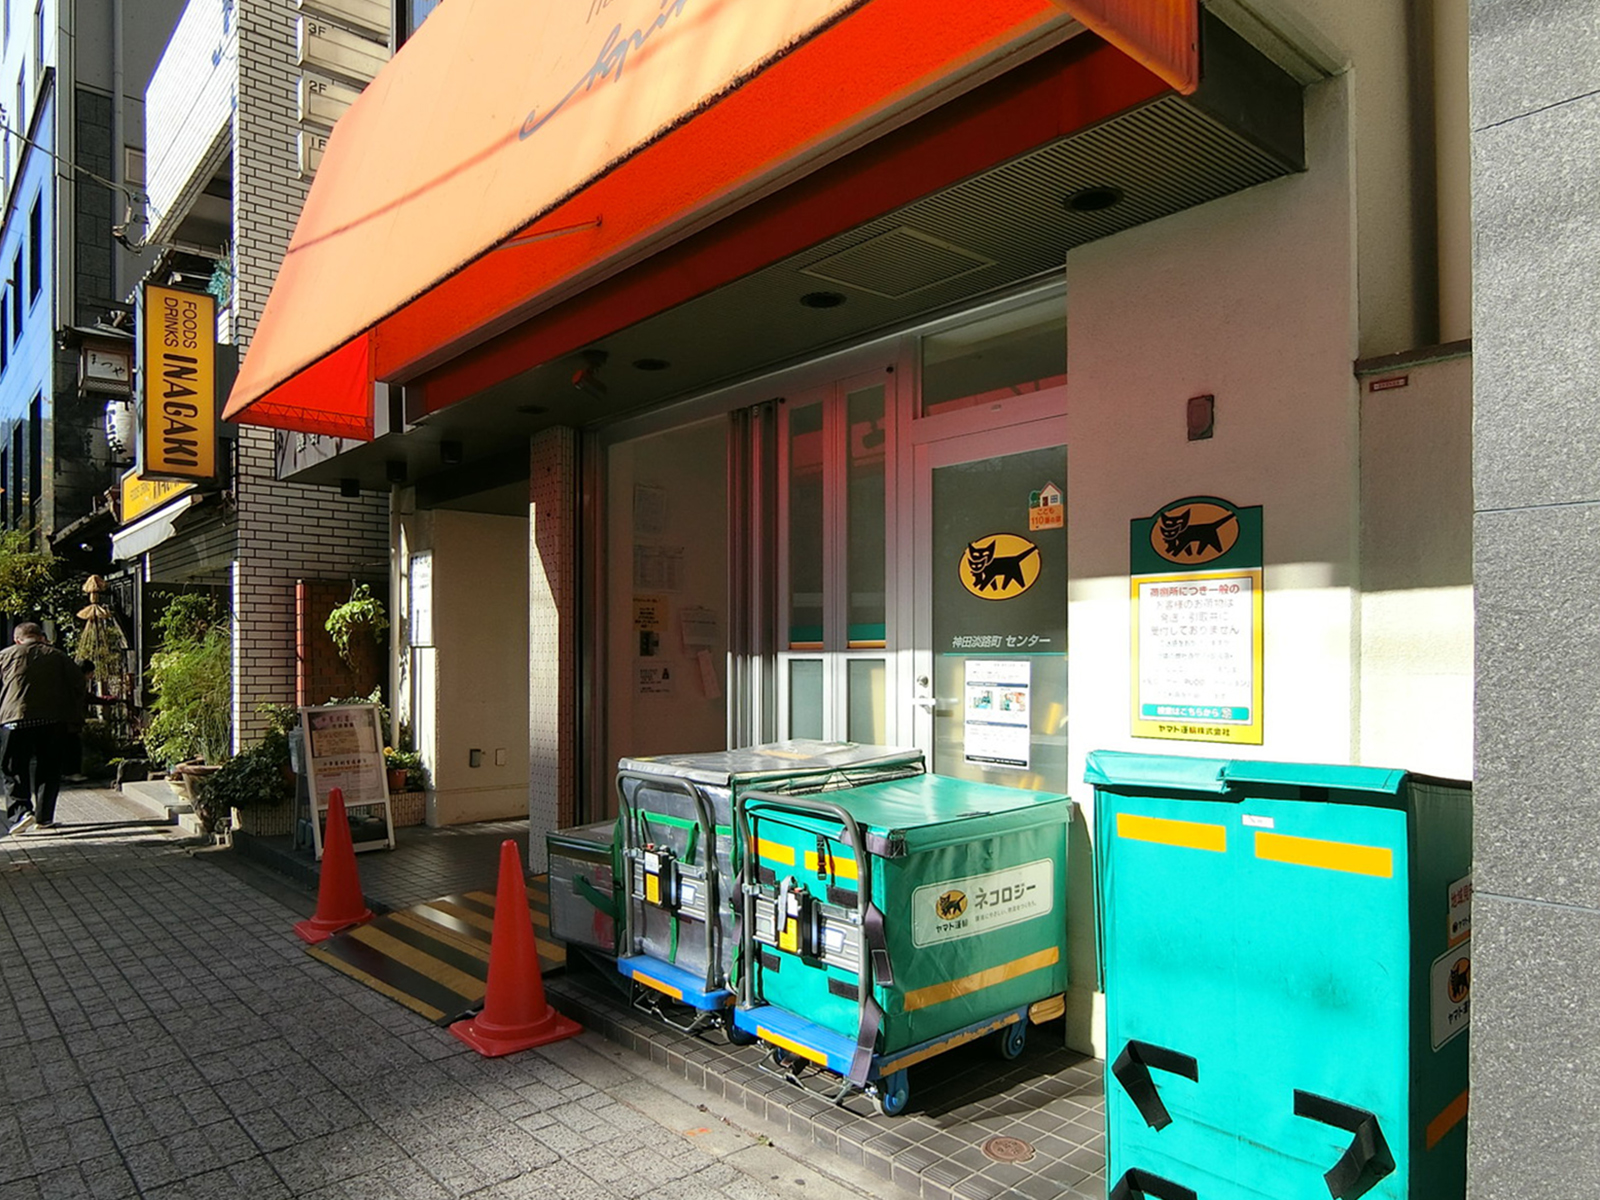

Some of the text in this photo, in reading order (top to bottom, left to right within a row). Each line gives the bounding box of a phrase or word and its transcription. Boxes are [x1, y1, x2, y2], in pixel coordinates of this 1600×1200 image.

[308, 22, 327, 35] 3F
[309, 80, 328, 93] 2F
[310, 136, 328, 149] 1F
[163, 296, 179, 348] DRINKS
[182, 300, 198, 349] FOODS
[90, 353, 126, 377] まつや
[162, 352, 199, 467] INAGAKI
[951, 634, 1052, 649] 神田淡路町 センター
[1158, 724, 1231, 737] ヤマト運輸株式会社
[974, 882, 1037, 911] ネコロジー
